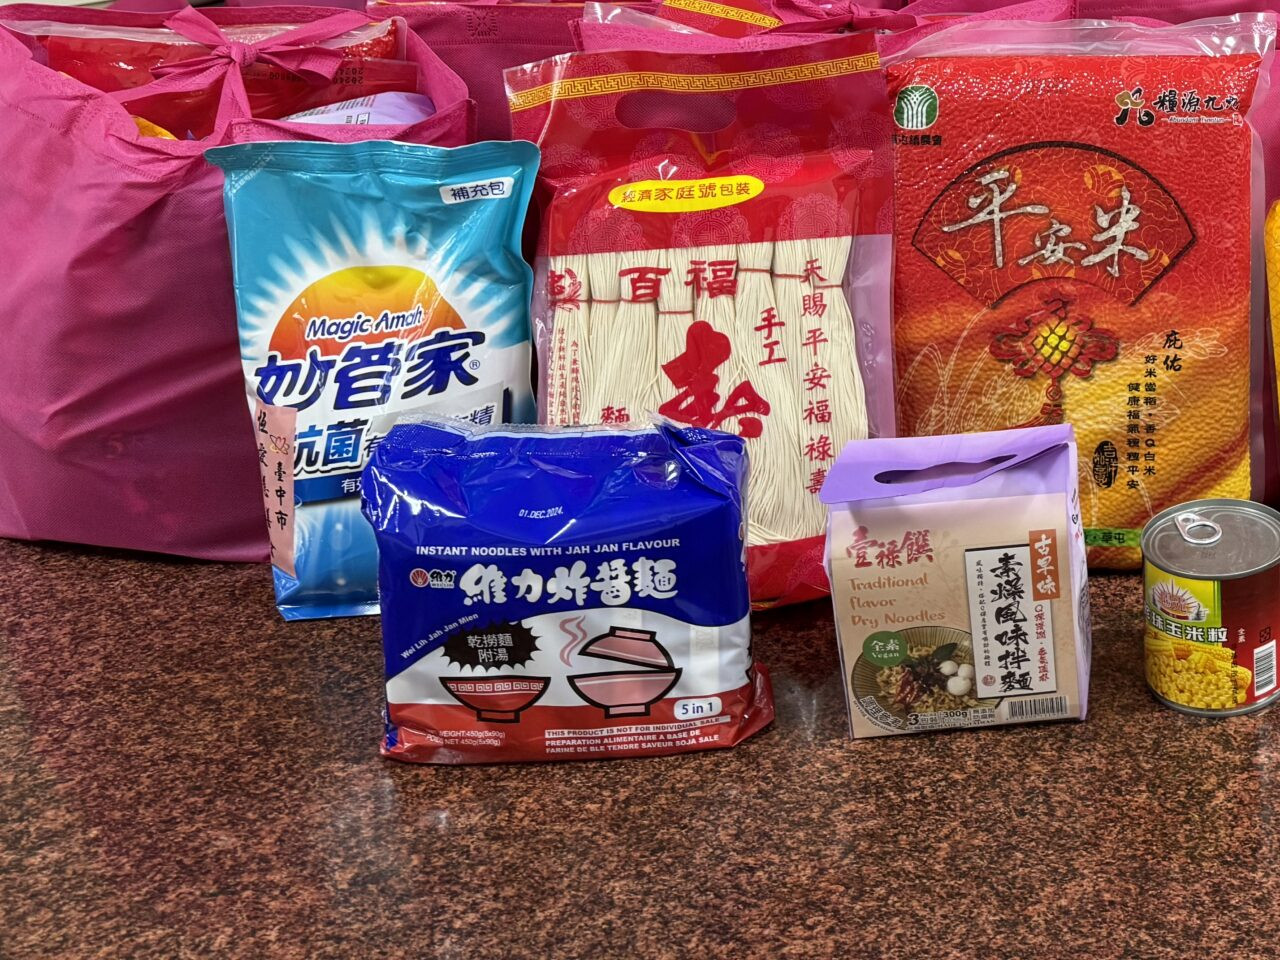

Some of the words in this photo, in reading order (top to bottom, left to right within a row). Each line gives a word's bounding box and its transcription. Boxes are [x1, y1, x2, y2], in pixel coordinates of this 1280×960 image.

[451, 181, 505, 200] 補充包
[621, 182, 751, 203] 經濟家庭號包裝
[942, 170, 1149, 276] 平安米
[619, 260, 737, 302] 百福
[307, 316, 371, 339] Magic
[375, 306, 422, 331] Amah
[755, 307, 786, 367] 手工
[1162, 330, 1183, 372] 庇佑
[255, 331, 485, 411] 妙管家
[275, 462, 288, 530] 臺中市
[416, 546, 468, 556] INSTANT
[471, 547, 527, 556] NOODLES
[530, 547, 561, 556] WITH
[565, 546, 590, 555] JAH
[594, 543, 619, 553] JAN
[622, 539, 680, 551] FLAVOUR
[1034, 534, 1056, 594] 古早味
[459, 556, 678, 606] 維力炸醬麵
[848, 572, 929, 591] Traditional
[851, 615, 879, 629] Dry
[884, 610, 946, 625] Noodles
[401, 646, 416, 659] Wei
[415, 639, 428, 649] Lih
[429, 630, 443, 641] Jah
[444, 623, 458, 632] Jan
[458, 613, 479, 625] Mien
[871, 639, 900, 651] 全素
[478, 648, 508, 663] 附湯
[872, 651, 899, 659] Vegan
[681, 704, 689, 715] 5
[692, 703, 704, 714] in
[708, 702, 713, 712] 1
[944, 711, 967, 719] 300g
[908, 713, 919, 725] 3
[545, 738, 601, 746] PREPARATION
[603, 735, 657, 744] ALIMENTAIRE
[667, 732, 688, 740] BASE
[547, 729, 566, 737] THIS
[652, 722, 698, 731] INDIVIDUAL
[546, 746, 575, 754] FARINE
[607, 743, 639, 751] TENDRE
[641, 740, 673, 749] SAVEUR
[675, 738, 697, 747] SOJA
[698, 735, 720, 743] SALE
